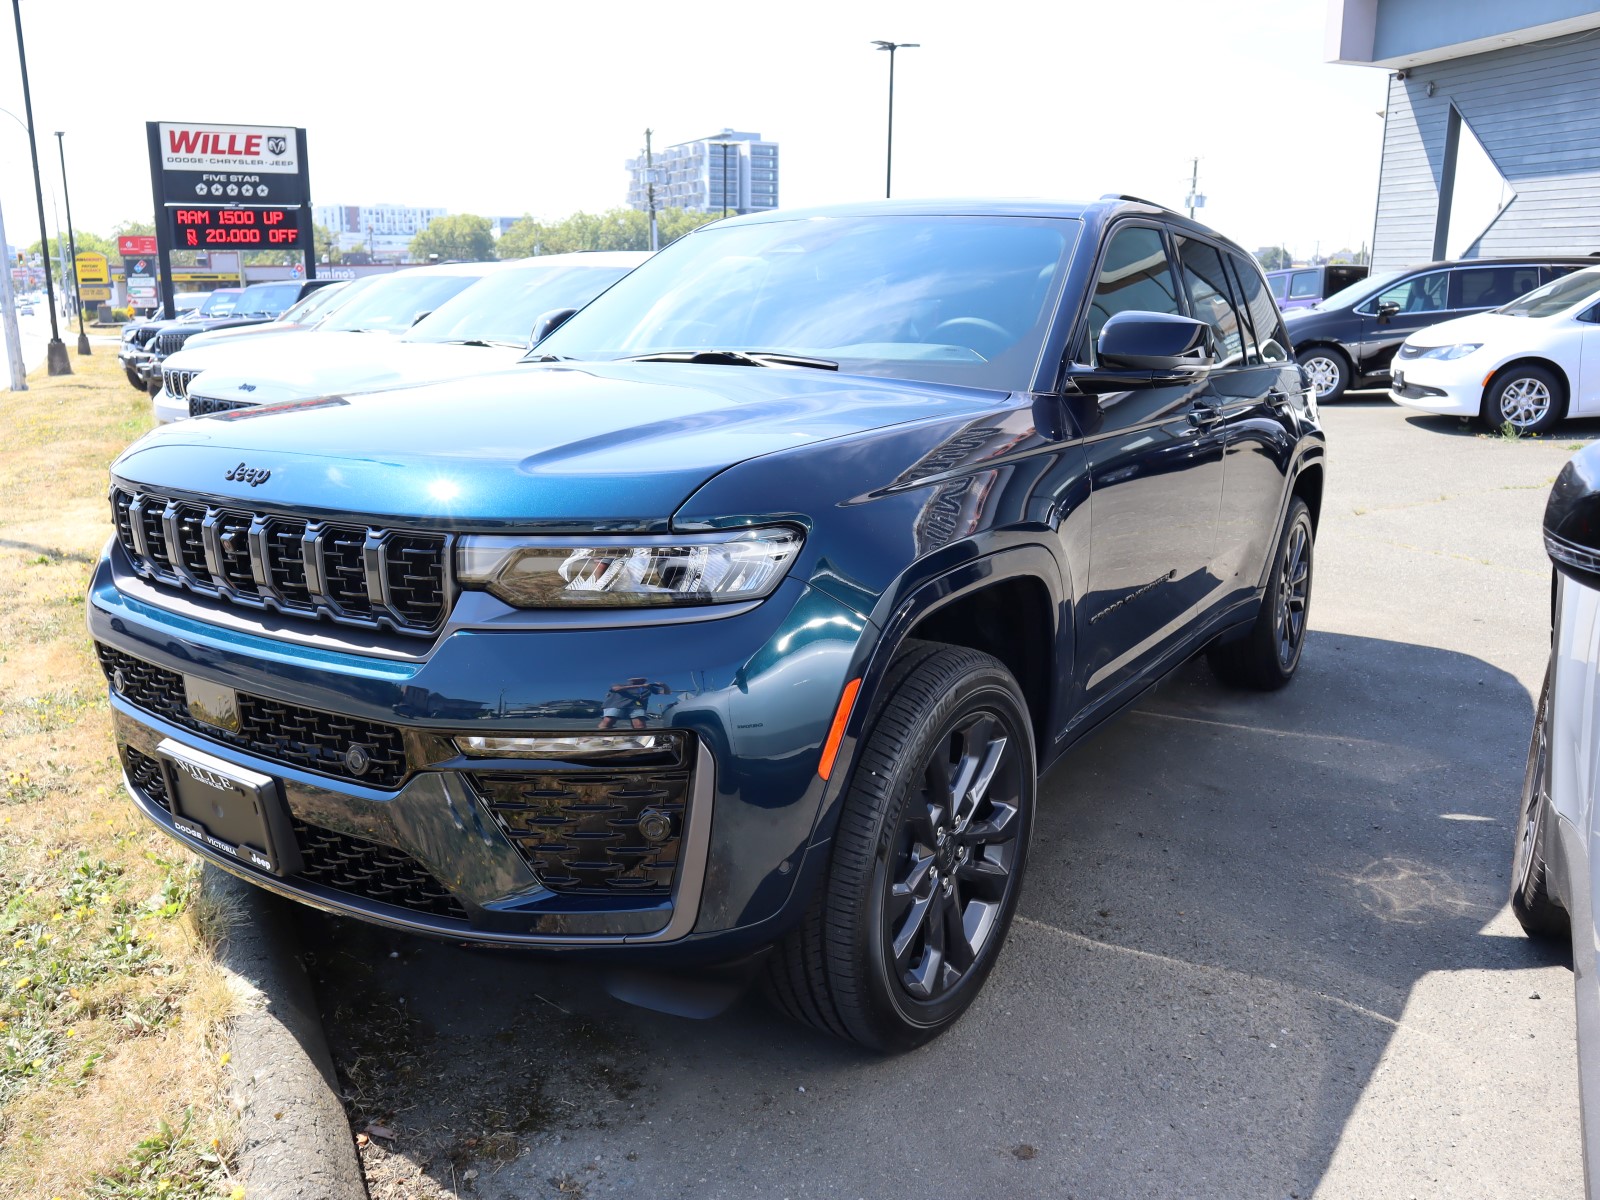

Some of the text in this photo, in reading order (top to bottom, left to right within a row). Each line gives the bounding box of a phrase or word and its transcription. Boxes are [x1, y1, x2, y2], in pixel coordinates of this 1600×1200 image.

[169, 131, 262, 156] WILLE
[209, 158, 264, 166] CHRYSLER
[203, 174, 259, 183] FIVE STAR
[177, 211, 283, 224] RAM 1500 UP
[206, 229, 260, 243] 20,000
[269, 229, 297, 242] OFF
[315, 268, 356, 279] omino's
[224, 462, 271, 488] Jeep
[175, 758, 233, 790] WILLE
[174, 822, 271, 870] DODGE VICTORIA Jeep
